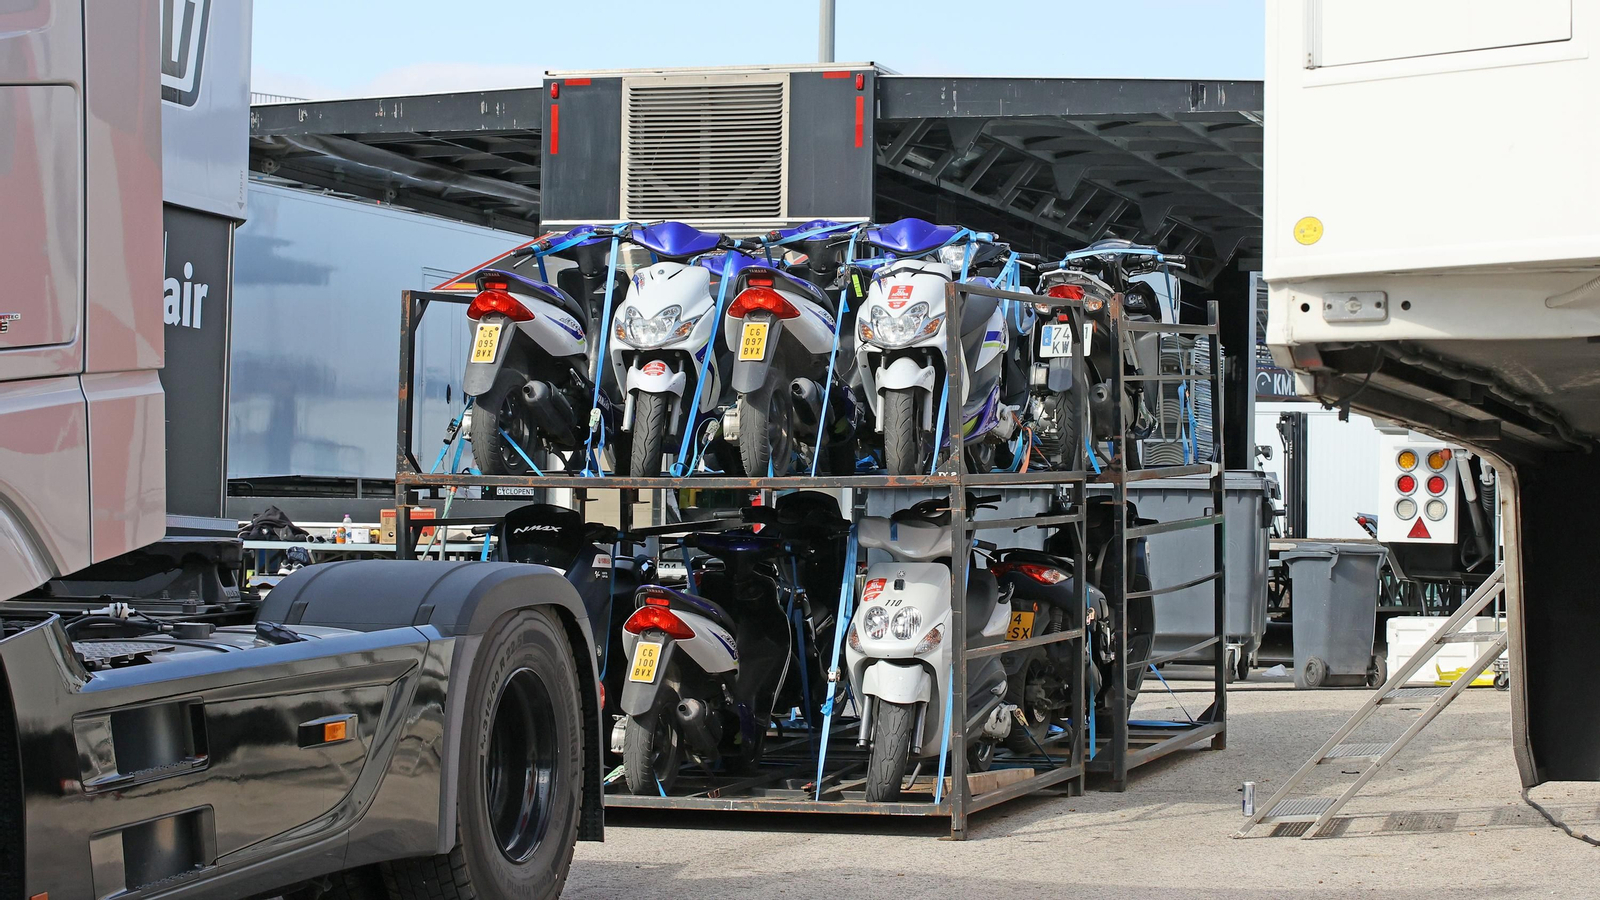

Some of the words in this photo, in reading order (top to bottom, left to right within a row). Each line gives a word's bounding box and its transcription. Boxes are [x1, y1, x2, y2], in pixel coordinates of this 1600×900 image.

[750, 328, 761, 336] C6
[478, 340, 494, 348] 095
[476, 349, 492, 357] BVX
[743, 347, 760, 355] BVX
[513, 524, 563, 535] NMAX
[885, 599, 903, 607] 110
[1010, 613, 1022, 625] 4
[642, 648, 653, 657] C6
[499, 657, 505, 673] R
[638, 659, 654, 668] 100
[635, 668, 652, 677] BVX
